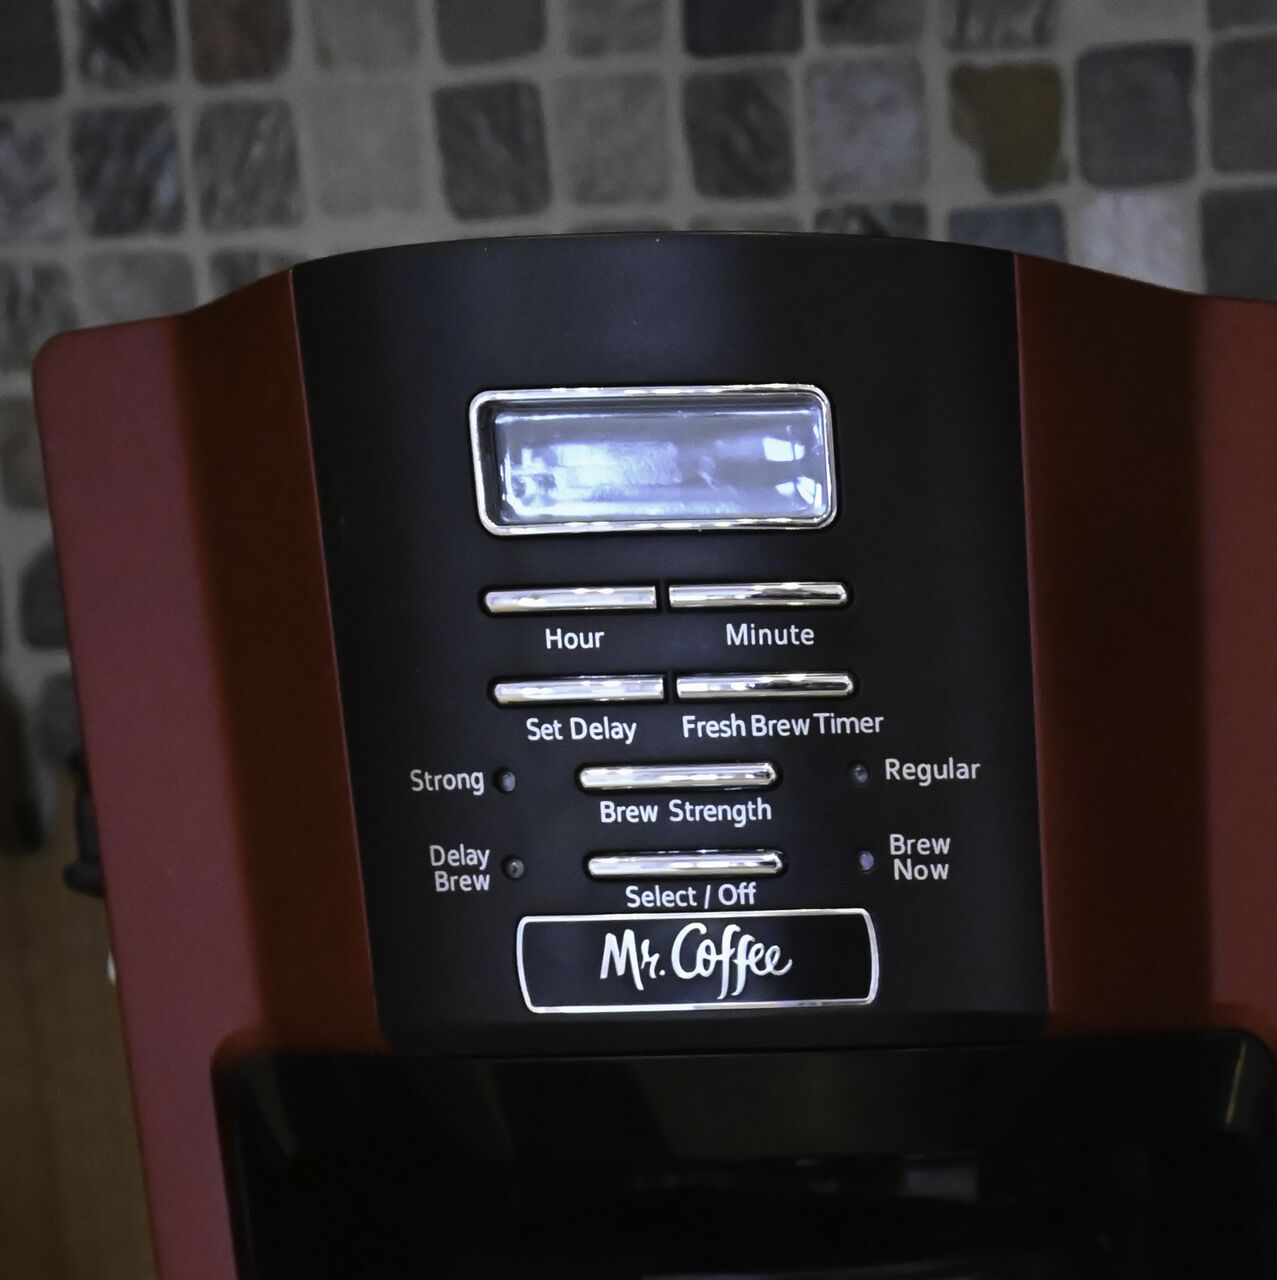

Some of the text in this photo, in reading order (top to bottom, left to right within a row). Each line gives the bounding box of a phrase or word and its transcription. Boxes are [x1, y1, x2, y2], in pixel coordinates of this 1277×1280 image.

[545, 628, 604, 650] Hour
[726, 624, 815, 646] Minute
[526, 717, 637, 745] Set Delay
[682, 713, 884, 738] Fresh Brew Timer
[410, 770, 485, 795] Strong
[884, 758, 981, 785] Regular
[600, 799, 772, 827] Brew Strength
[889, 834, 951, 855] Brew
[430, 846, 491, 872] Delay
[893, 859, 949, 880] Now
[435, 871, 491, 892] Brew
[625, 886, 697, 908] Select
[718, 883, 757, 906] Off
[601, 923, 793, 999] Mr. Coffee
